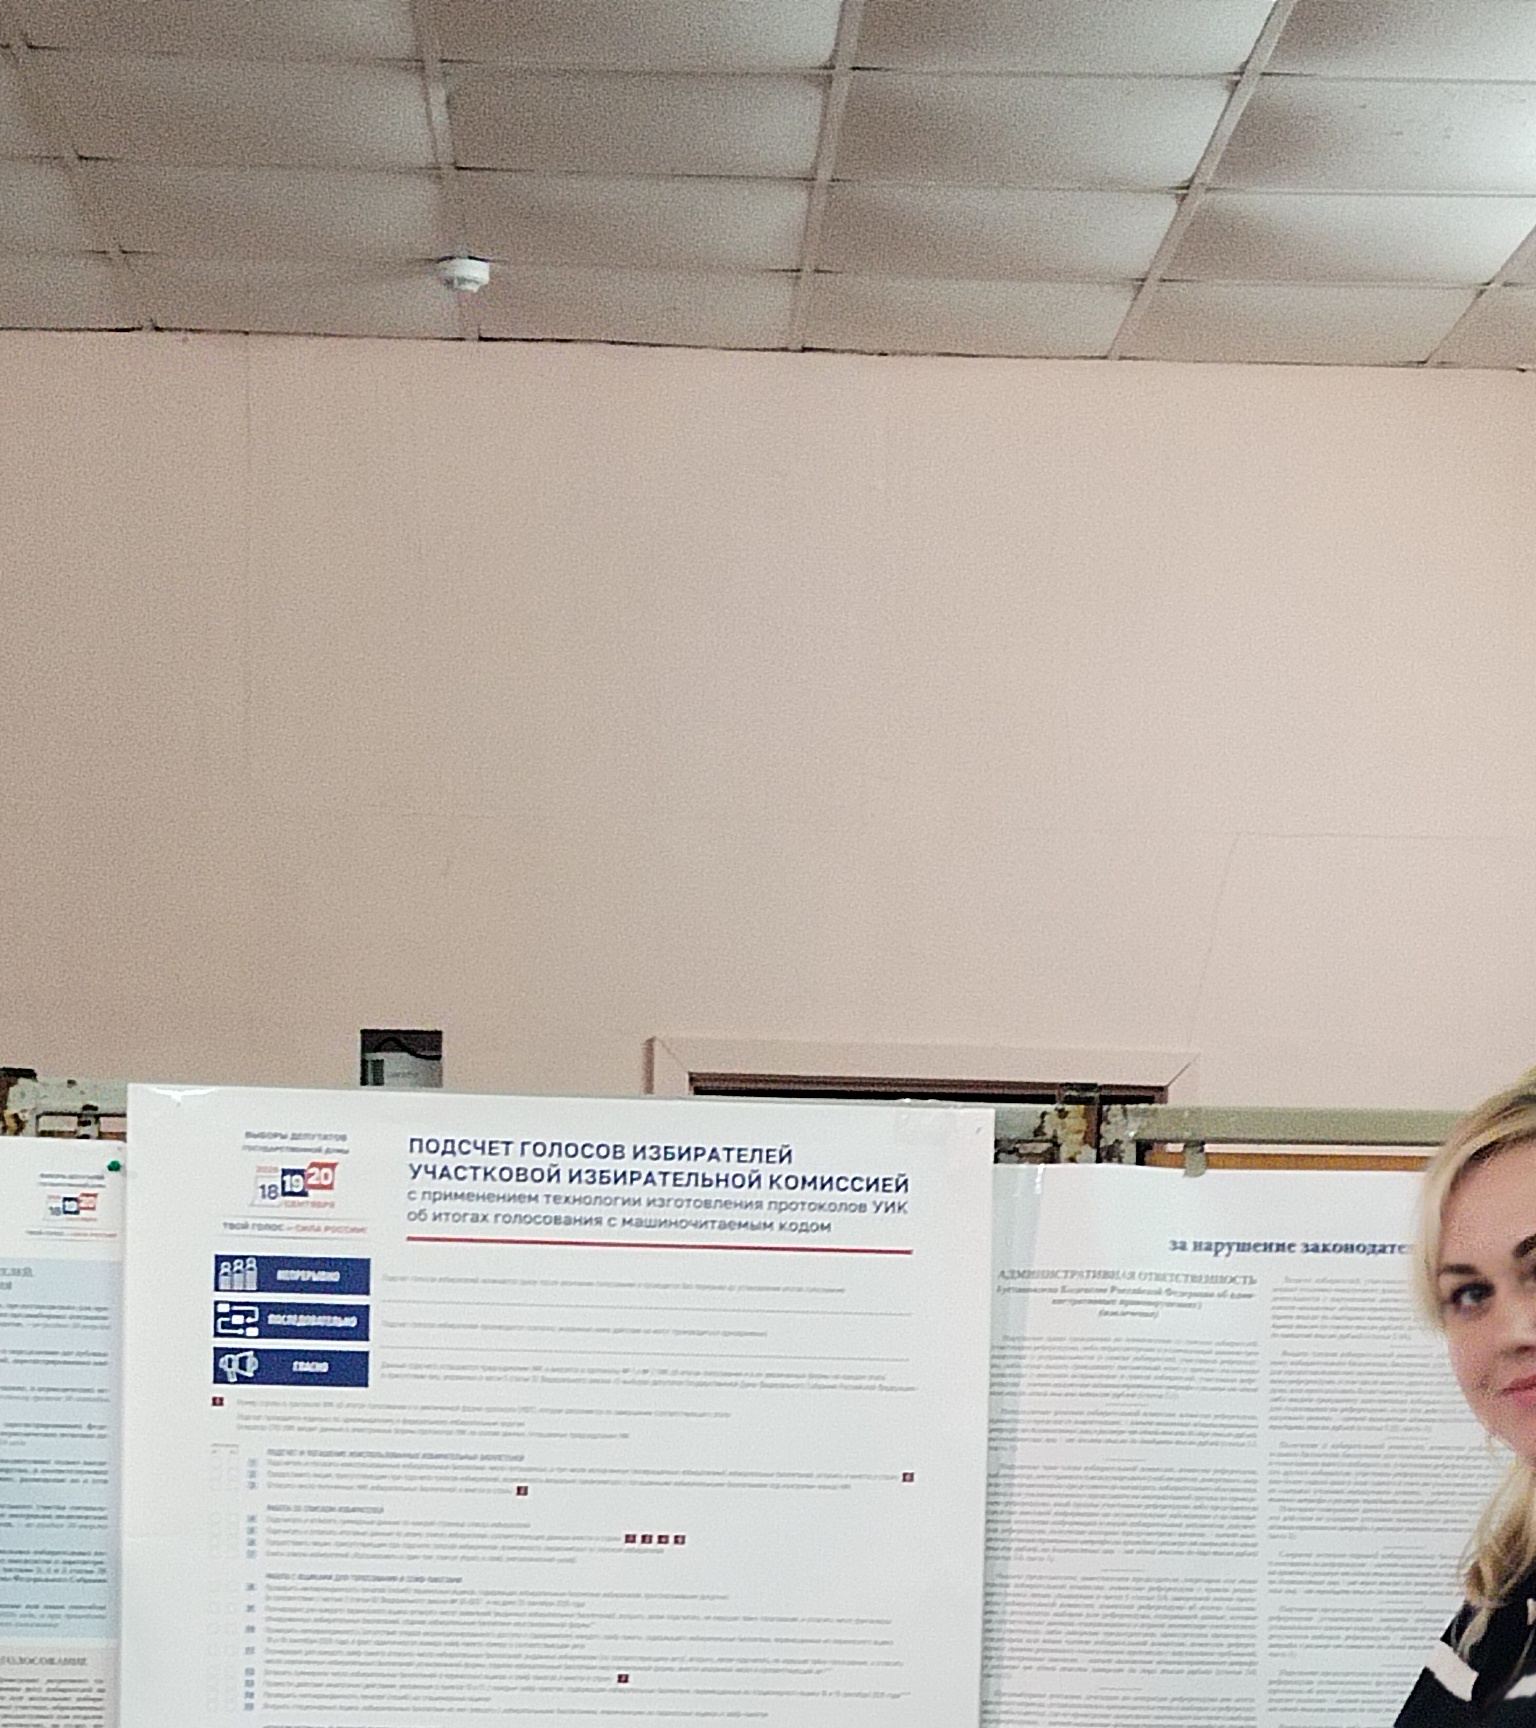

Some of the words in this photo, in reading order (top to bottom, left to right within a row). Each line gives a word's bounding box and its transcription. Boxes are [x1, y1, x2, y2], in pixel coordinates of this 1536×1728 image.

[409, 1138, 514, 1157] ПОДСЧЕТ
[520, 1141, 626, 1160] ГОЛОСОВ
[632, 1144, 793, 1164] ИЗБИРАТЕЛЕЙ
[259, 1184, 279, 1200] 18
[282, 1174, 304, 1192] 19
[307, 1167, 333, 1185] 20
[408, 1163, 561, 1184] УЧАСТКОВОЙ
[568, 1168, 762, 1190] ИЗБИРАТЕЛЬНОЙ
[768, 1173, 909, 1194] КОМИССИЕЙ
[407, 1190, 417, 1201] с
[421, 1190, 539, 1204] применением
[544, 1193, 642, 1207] технологии
[646, 1196, 763, 1210] изготовления
[767, 1200, 867, 1215] протоколов
[873, 1201, 908, 1215] УИК
[407, 1208, 427, 1222] об
[432, 1211, 488, 1223] итогах
[493, 1213, 603, 1227] голосования
[607, 1217, 617, 1227] с
[622, 1218, 774, 1231] машиночитаемым
[779, 1221, 831, 1234] кодом
[1168, 1239, 1187, 1252] за
[1192, 1240, 1297, 1258] нарушение
[1300, 1241, 1409, 1256] законодате
